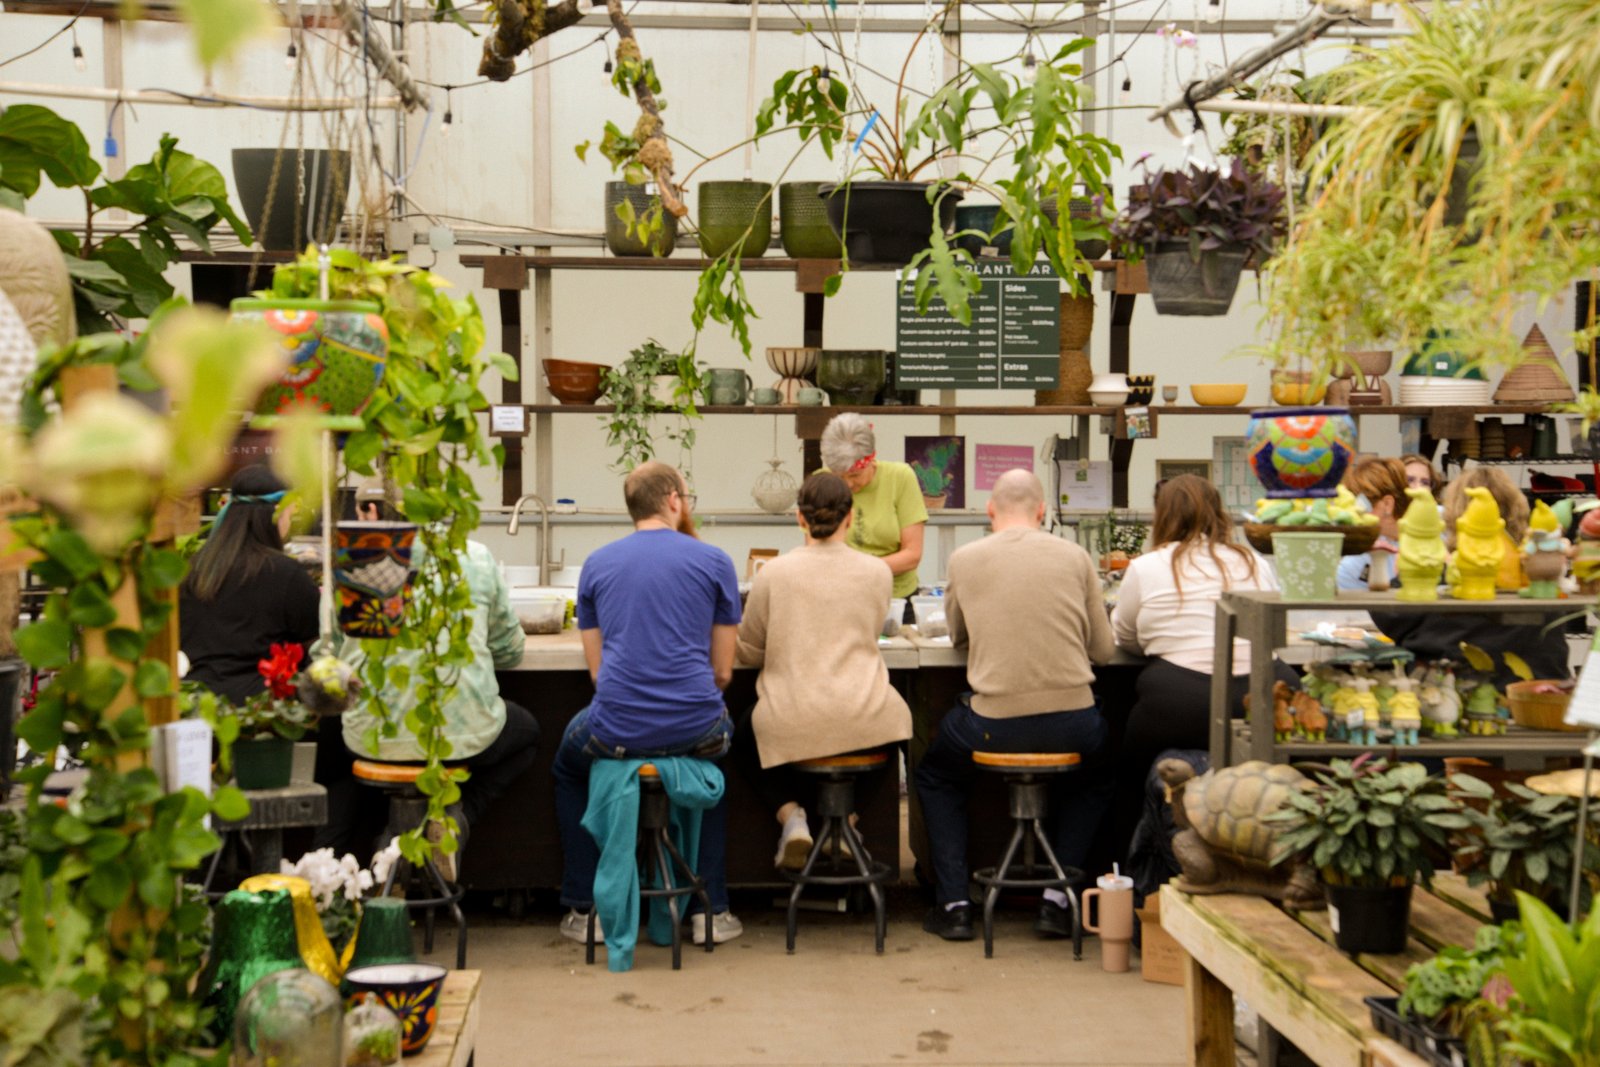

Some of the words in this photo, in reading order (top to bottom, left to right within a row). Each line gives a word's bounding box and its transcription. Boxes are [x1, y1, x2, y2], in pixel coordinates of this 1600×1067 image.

[964, 264, 1013, 274] PLANT
[1026, 264, 1051, 274] AR
[1004, 284, 1026, 292] Sides
